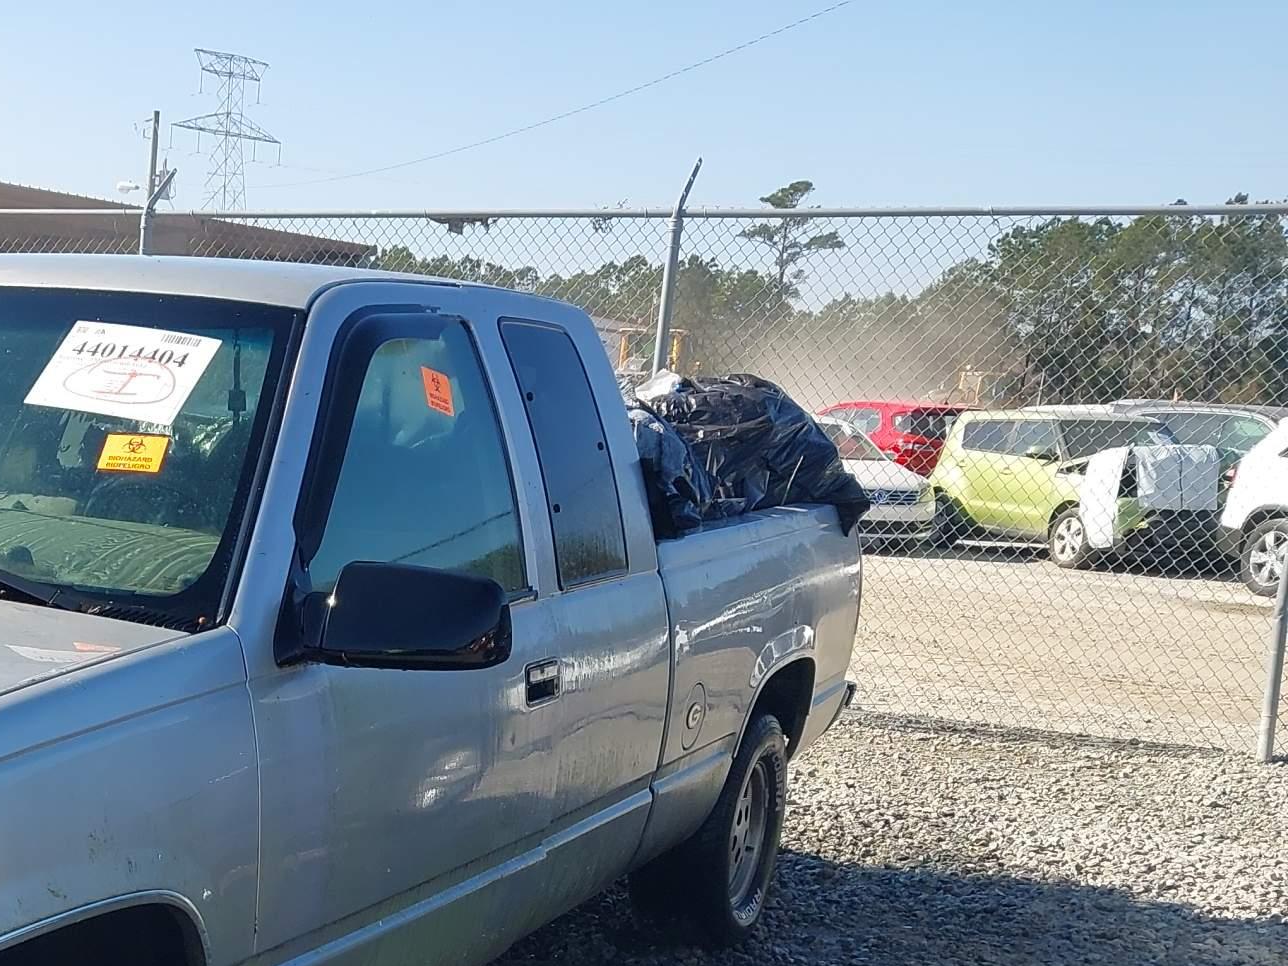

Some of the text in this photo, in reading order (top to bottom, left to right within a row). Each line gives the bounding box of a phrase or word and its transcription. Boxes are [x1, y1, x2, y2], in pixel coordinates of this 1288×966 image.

[72, 341, 189, 367] 44014404
[108, 455, 153, 463] BIOHAZARD
[105, 462, 151, 470] BIOPELIGRO
